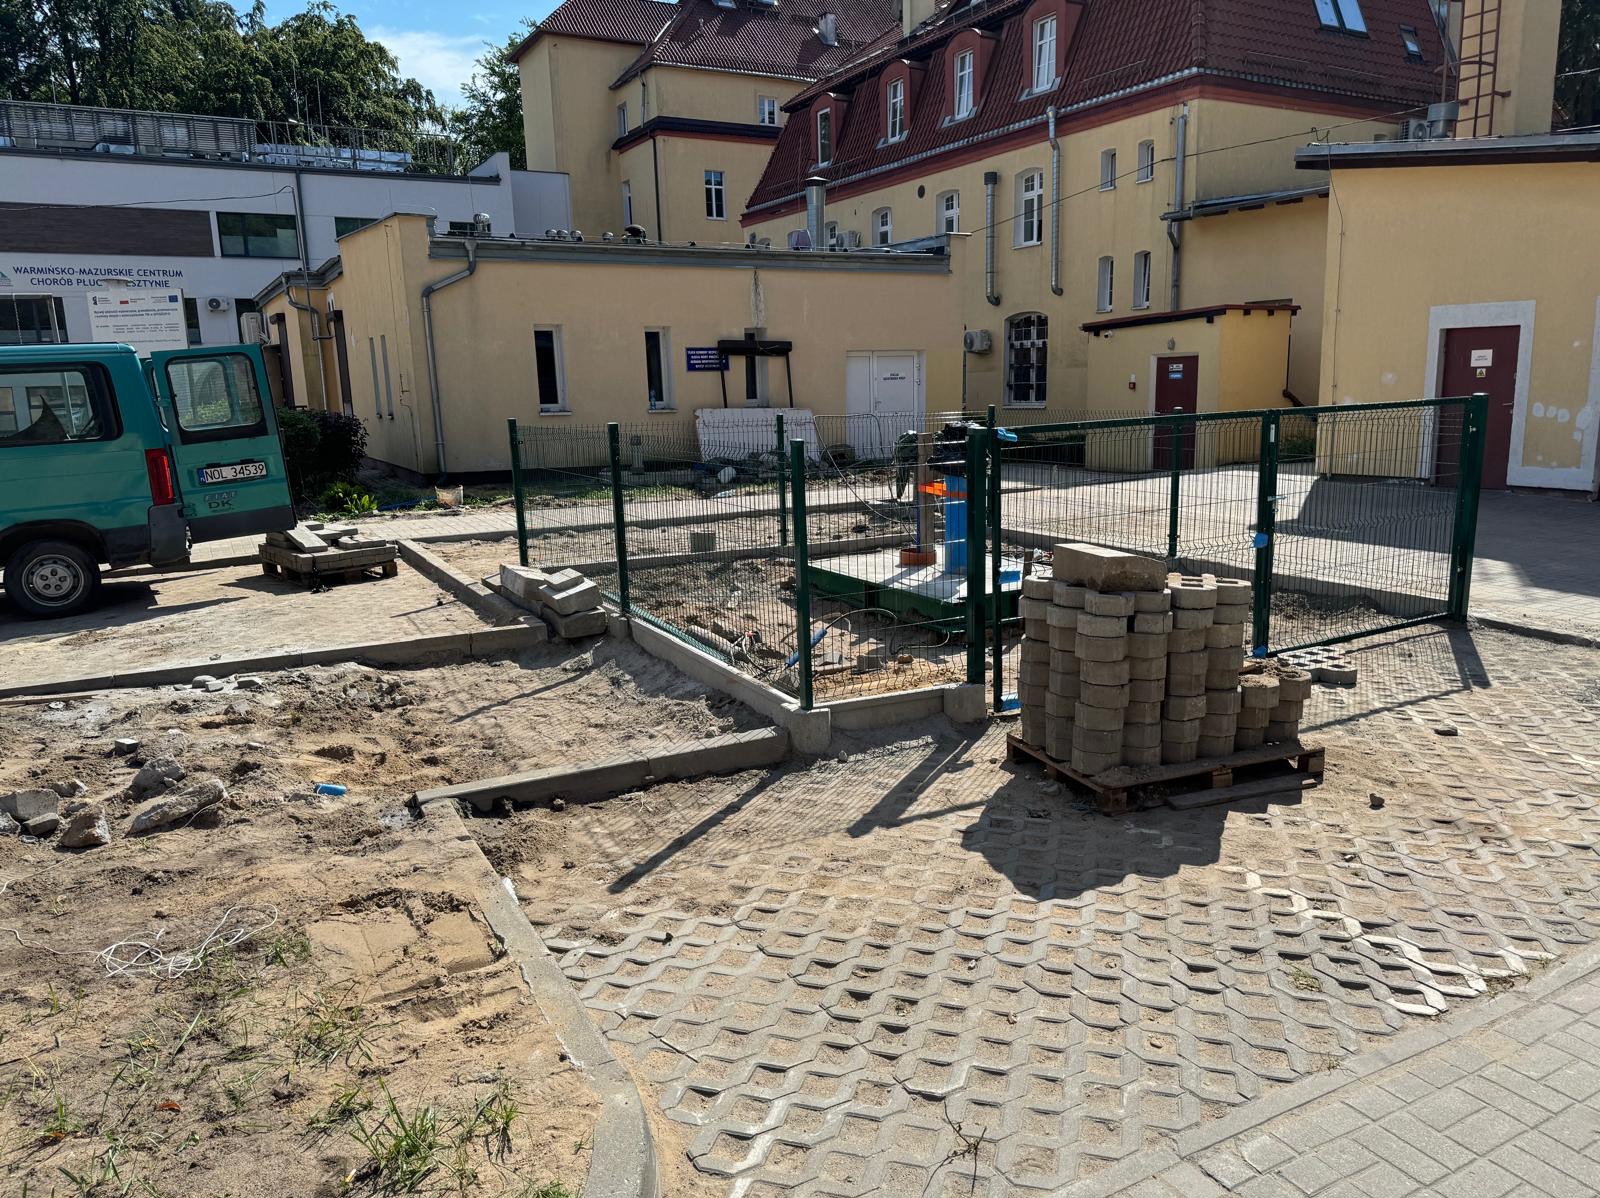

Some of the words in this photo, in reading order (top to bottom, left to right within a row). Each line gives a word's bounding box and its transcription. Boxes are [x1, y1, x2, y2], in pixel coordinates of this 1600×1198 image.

[13, 265, 134, 277] WARMIŃSKO-MAZURSKIE
[136, 268, 183, 278] CENTRUM
[30, 277, 74, 286] CHORÓB
[77, 278, 103, 287] PŁUC
[205, 469, 227, 481] NOL
[231, 464, 264, 477] 34539
